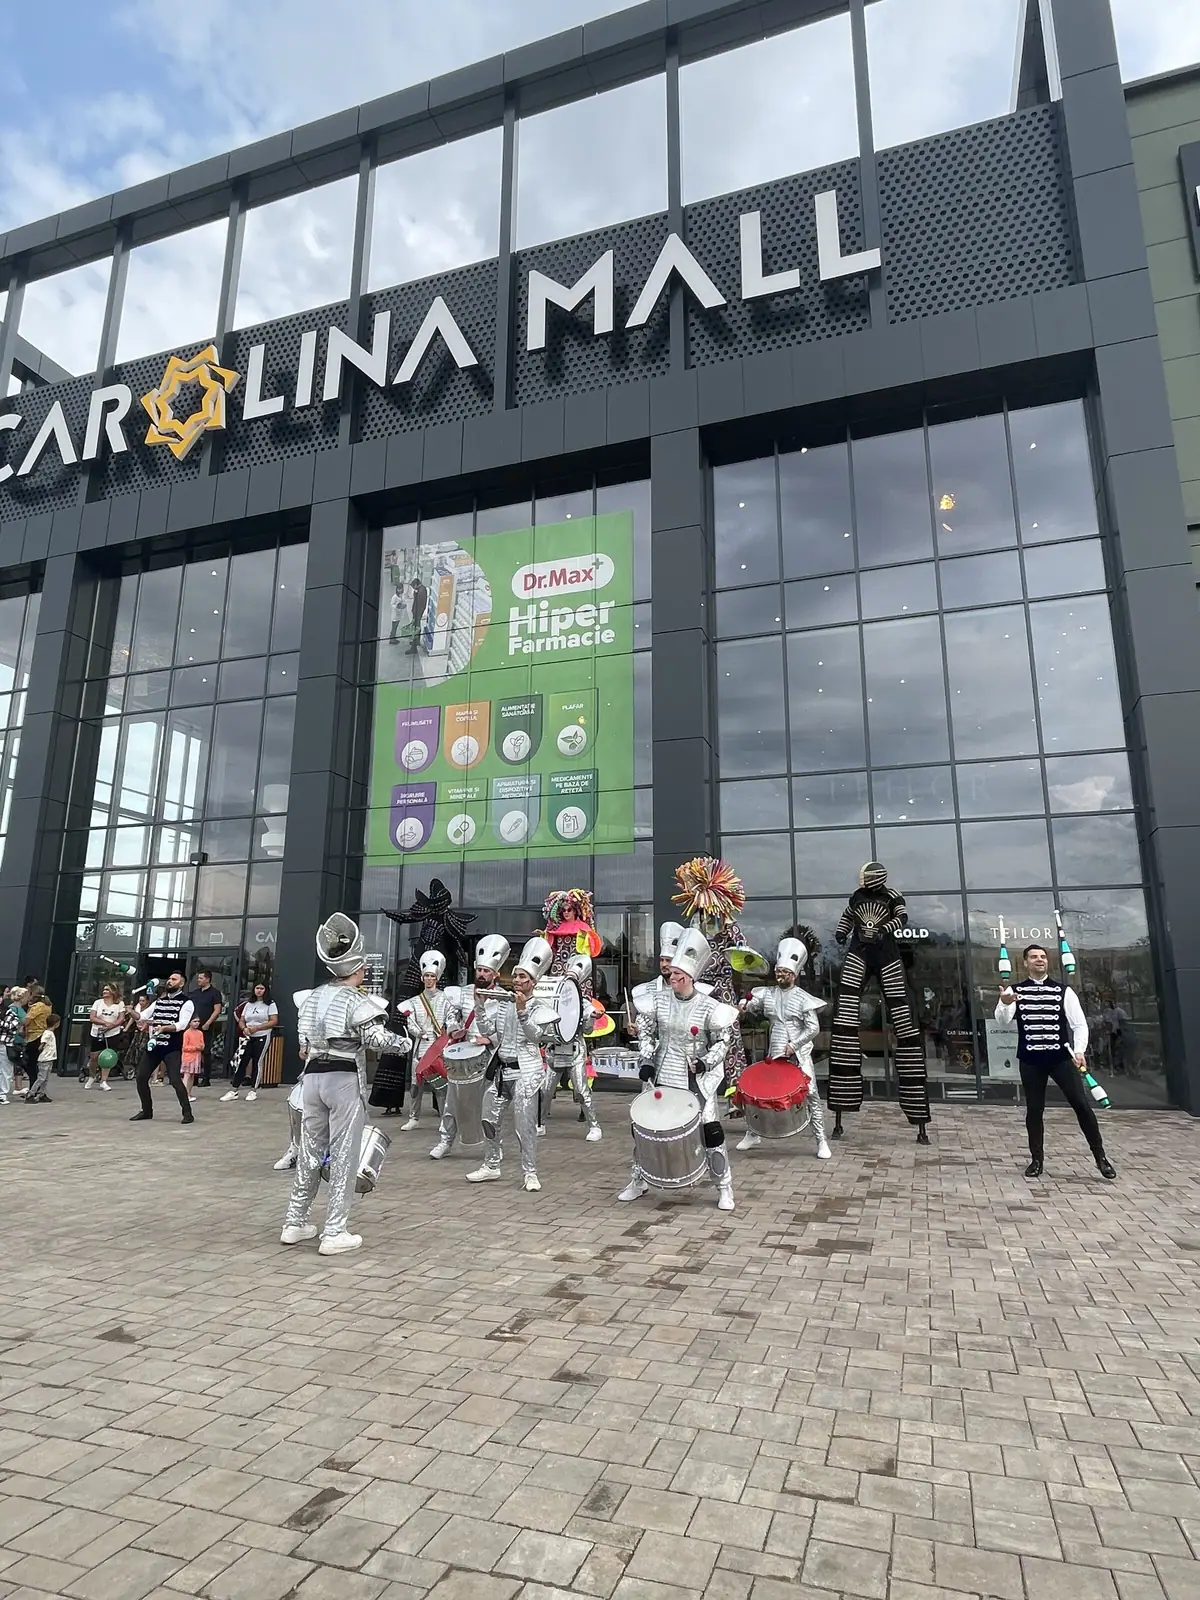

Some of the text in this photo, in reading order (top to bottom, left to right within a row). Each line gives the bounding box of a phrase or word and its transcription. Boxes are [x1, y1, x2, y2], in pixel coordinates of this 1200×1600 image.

[526, 189, 882, 351] MALL
[509, 600, 616, 637] Hiper
[508, 624, 616, 656] Farmacie
[561, 703, 584, 711] PLAFAR
[551, 774, 593, 783] MEDICAMENTE
[255, 931, 278, 943] CA
[893, 928, 929, 939] GOLD
[990, 927, 1053, 939] TEILOR
